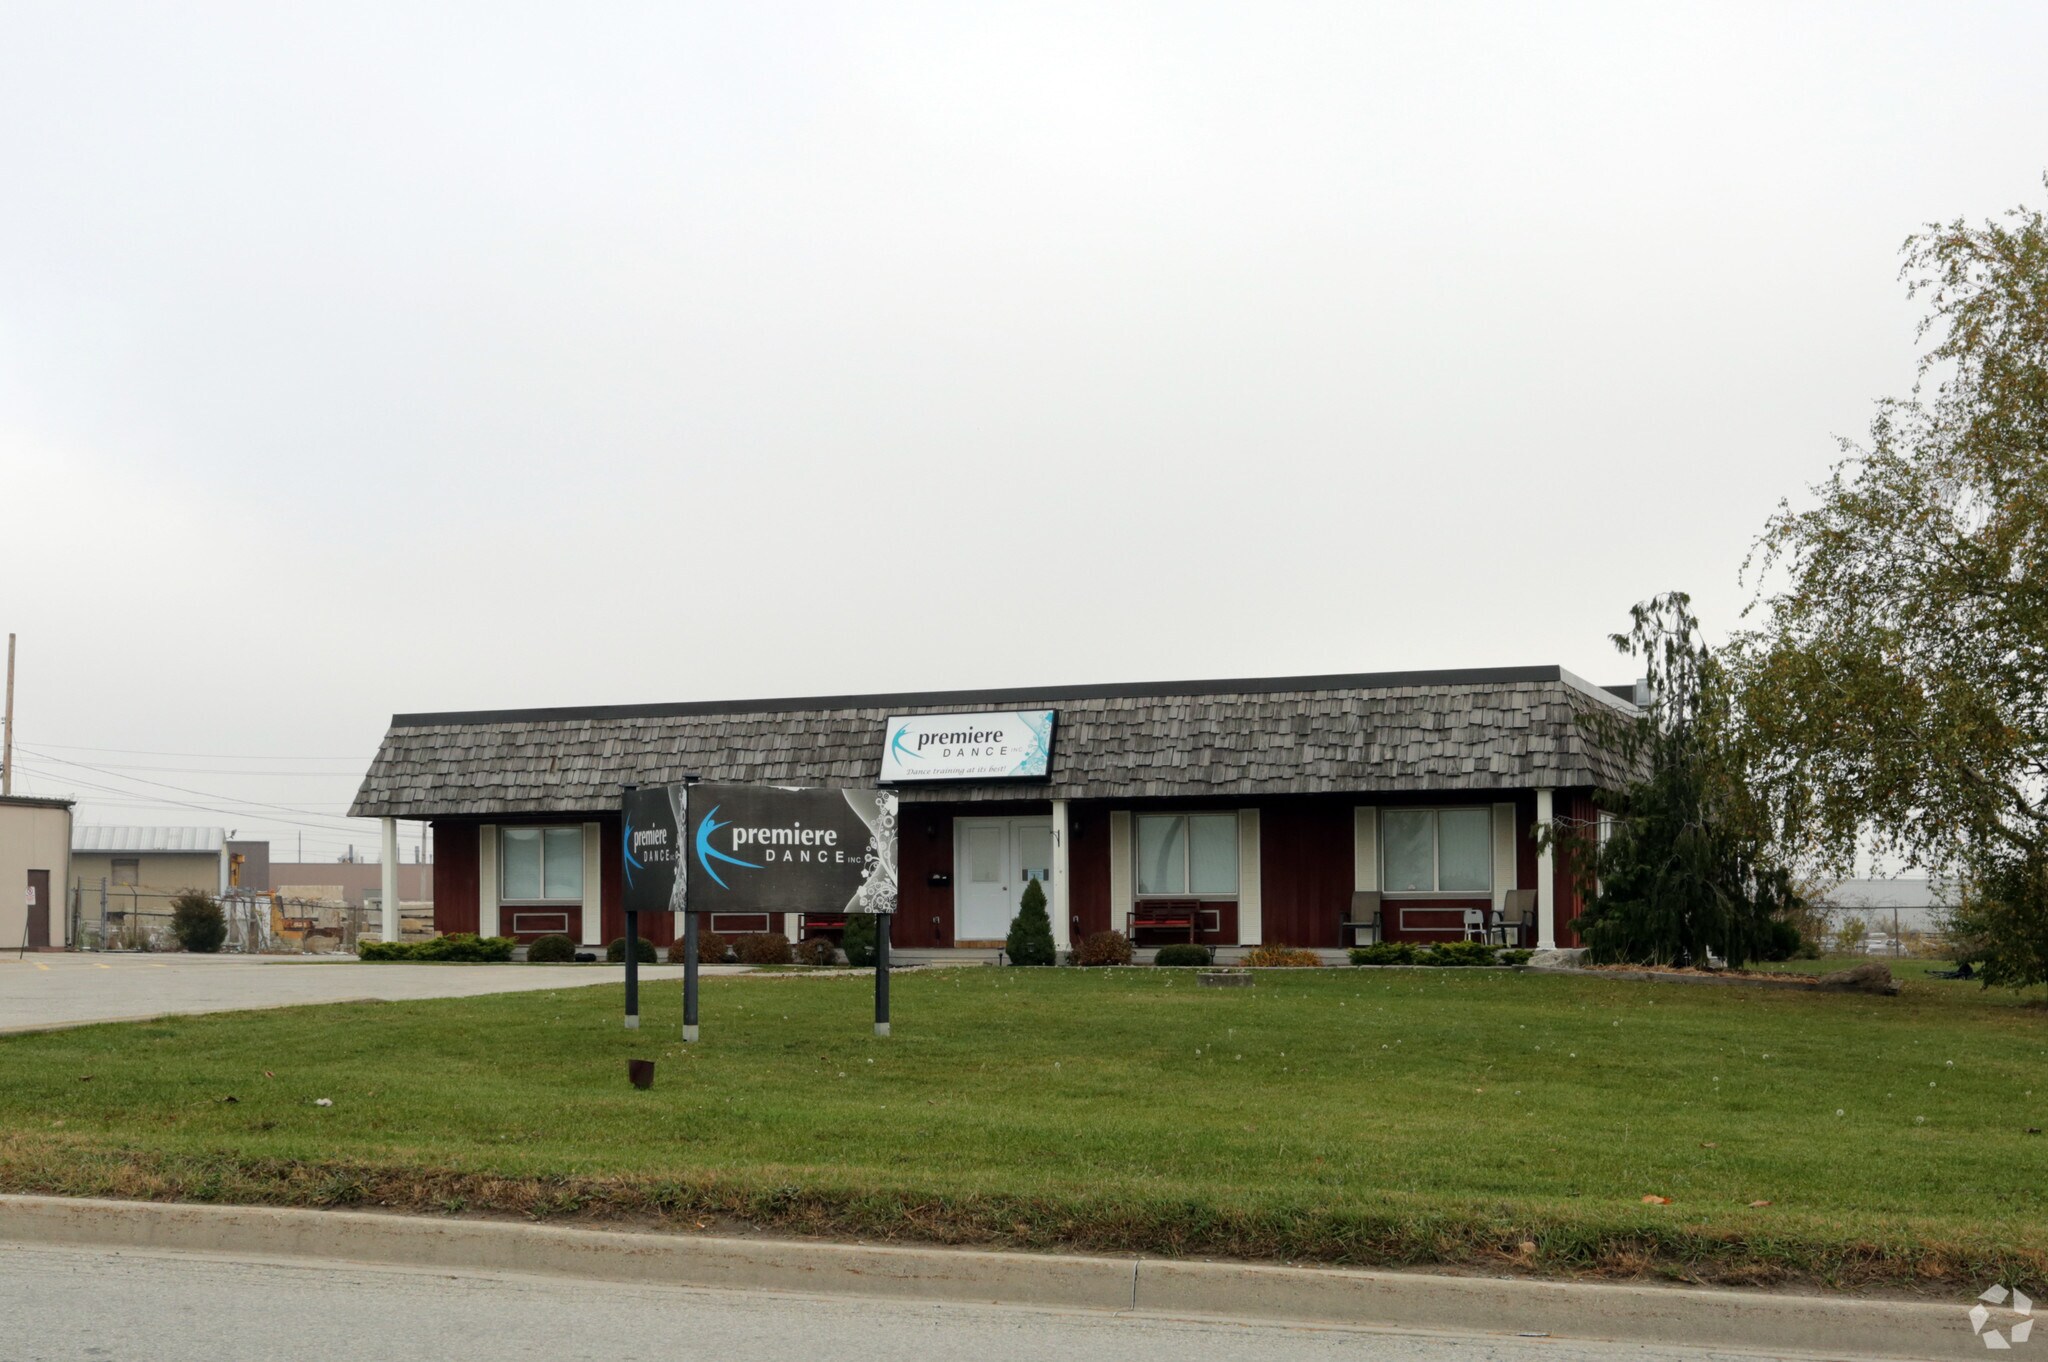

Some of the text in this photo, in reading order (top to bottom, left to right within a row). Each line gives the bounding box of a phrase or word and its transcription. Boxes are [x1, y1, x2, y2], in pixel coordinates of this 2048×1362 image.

[917, 726, 1004, 751] premiere
[942, 746, 1008, 758] DANCE
[906, 767, 930, 776] Dance
[932, 766, 965, 776] training
[633, 822, 667, 854] premiere
[732, 821, 838, 851] premiere
[643, 849, 670, 862] DANCE
[765, 849, 862, 864] DANCE INC
